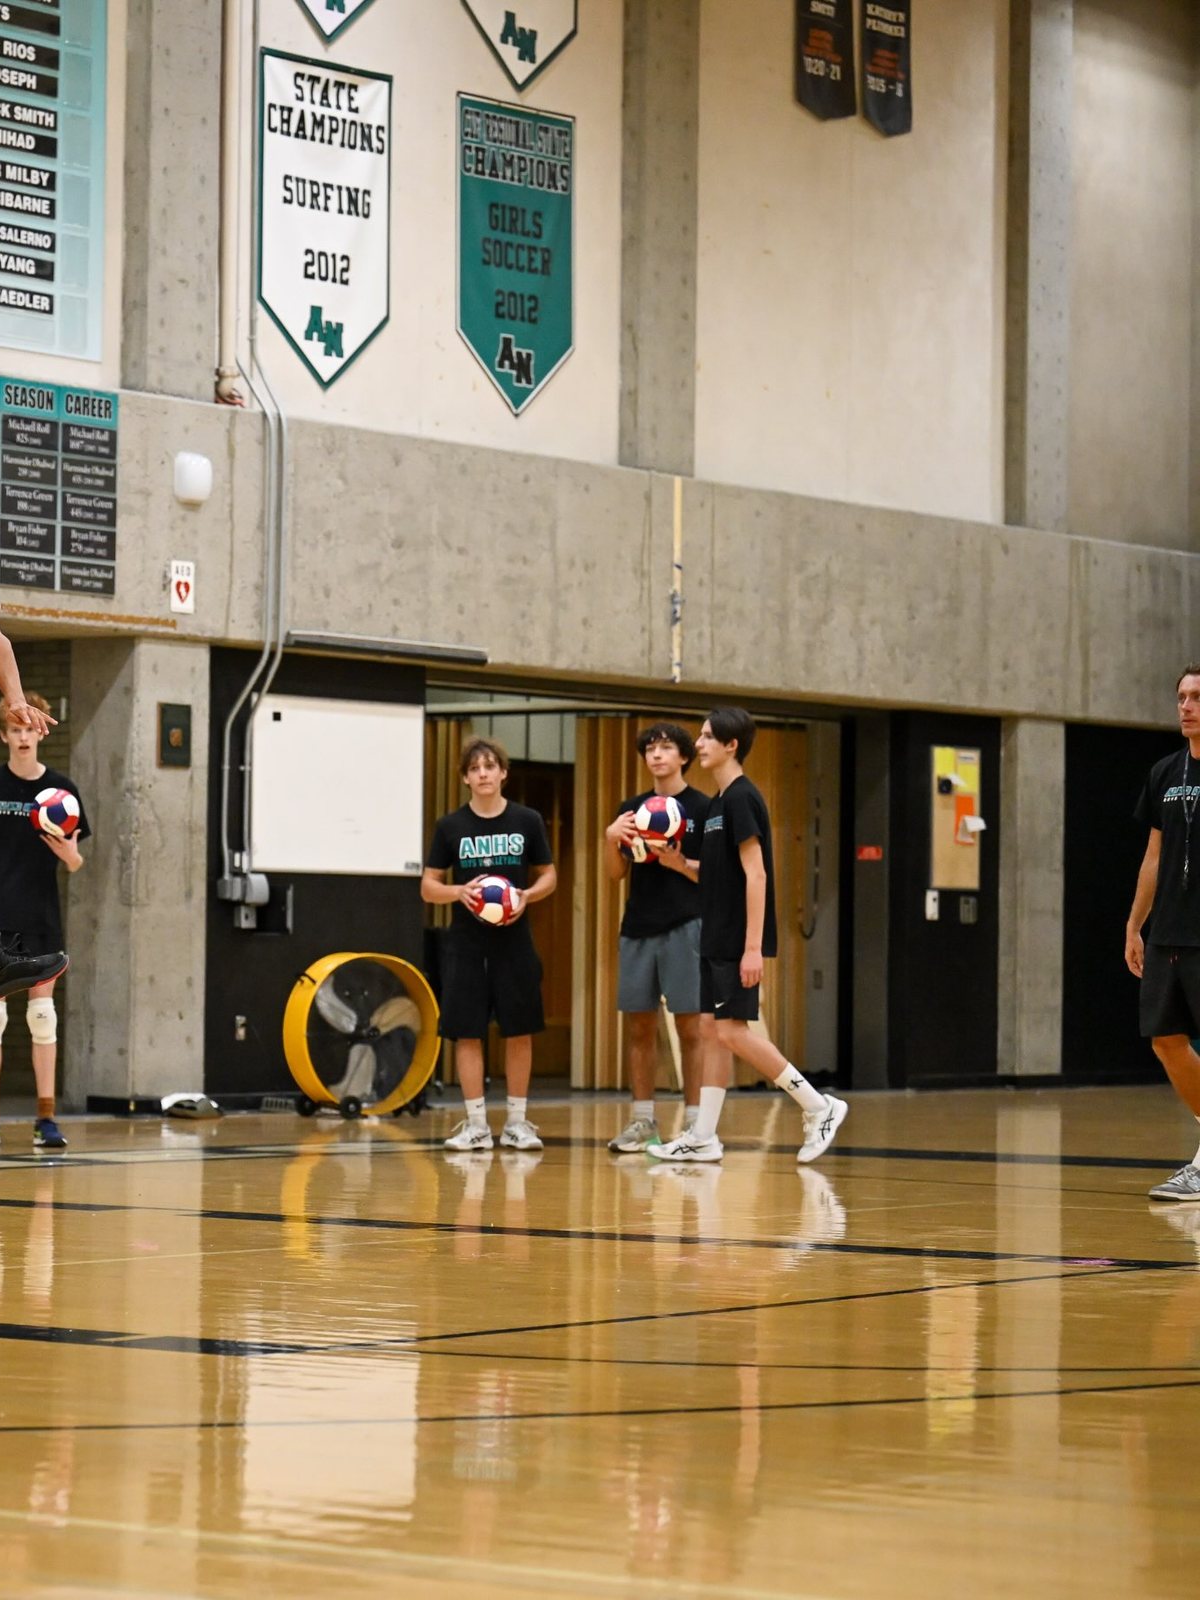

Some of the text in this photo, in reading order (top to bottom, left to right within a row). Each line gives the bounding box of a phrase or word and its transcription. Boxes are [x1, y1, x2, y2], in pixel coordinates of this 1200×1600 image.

[3, 40, 36, 61] RIOS
[500, 10, 537, 64] AN
[293, 72, 360, 114] STATE
[14, 106, 55, 127] SMITH
[267, 102, 385, 155] CHAMPIONS
[6, 165, 49, 186] MILBY
[462, 142, 570, 194] CHAMPIONS
[282, 174, 371, 219] SURFING
[0, 226, 51, 249] SALERNO
[488, 202, 544, 240] GIRLS
[304, 248, 350, 286] 2012
[481, 237, 552, 276] SOCCER
[494, 289, 539, 325] 2012
[304, 305, 344, 358] AN
[496, 333, 534, 388] AN
[4, 384, 54, 411] SEASON
[65, 393, 112, 420] CAREER
[459, 833, 524, 859] ANHS
